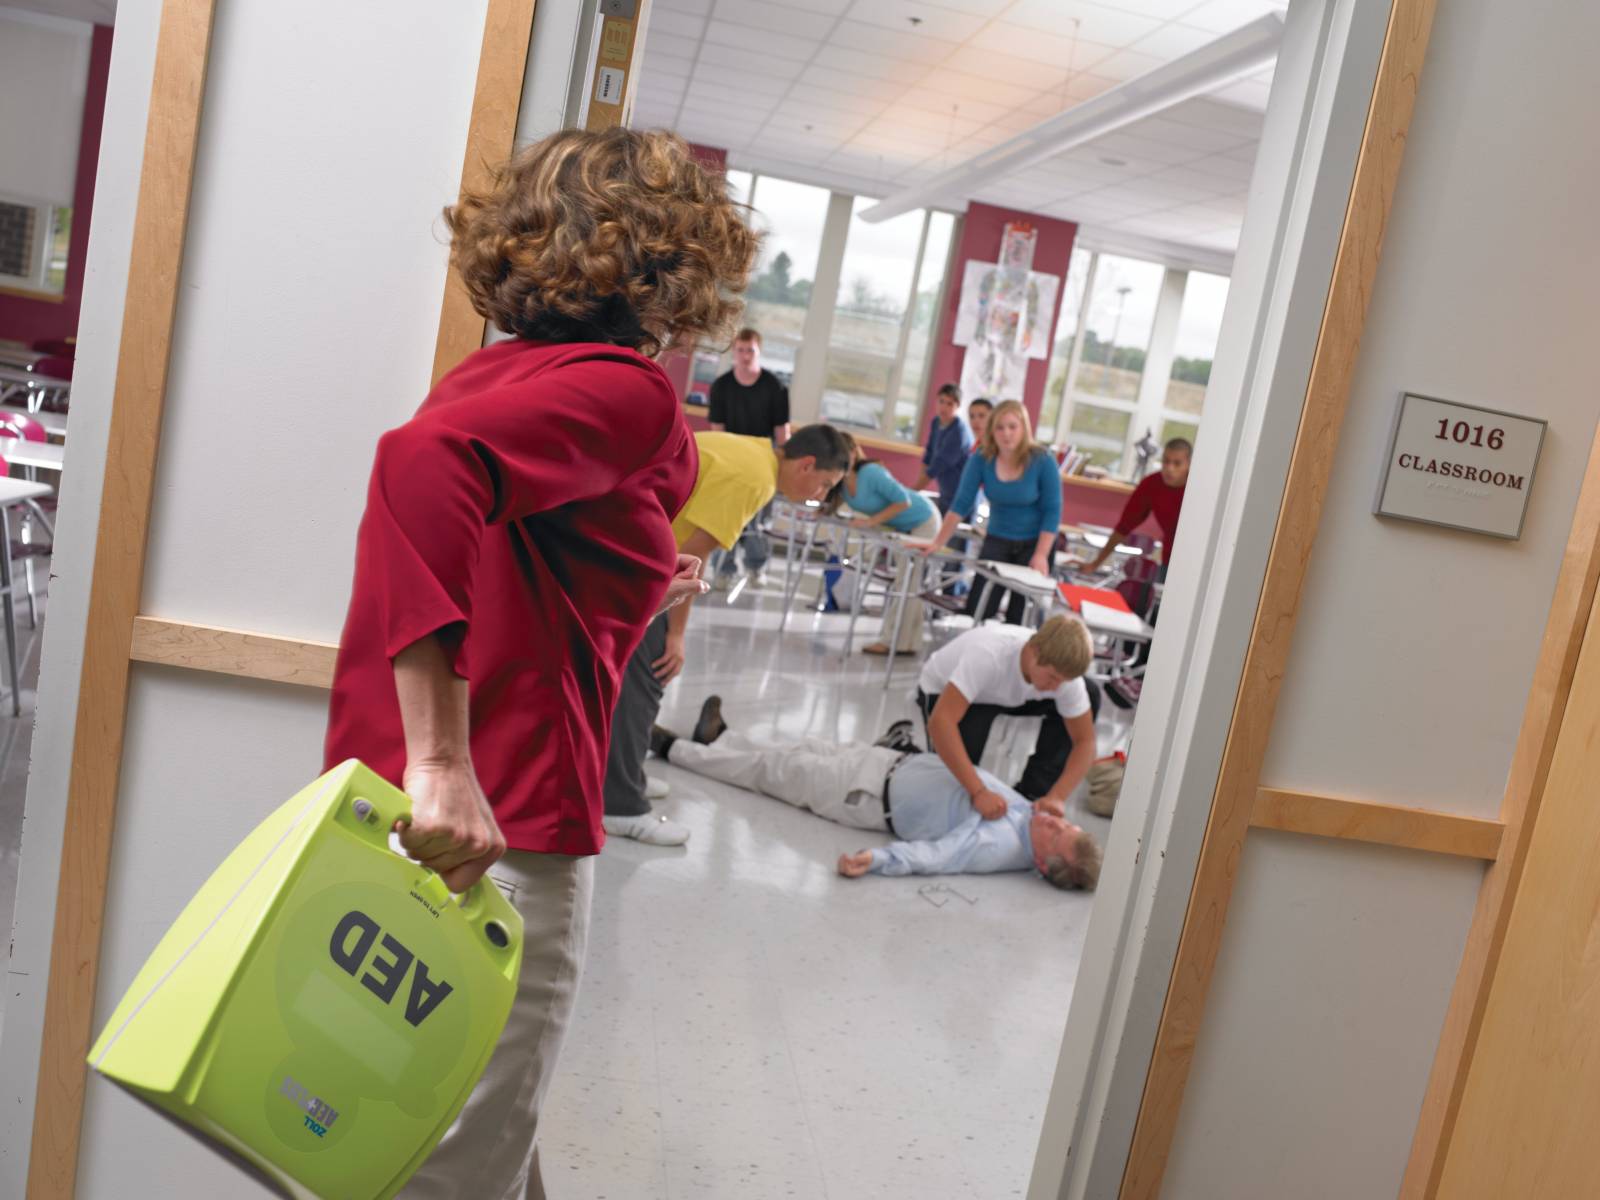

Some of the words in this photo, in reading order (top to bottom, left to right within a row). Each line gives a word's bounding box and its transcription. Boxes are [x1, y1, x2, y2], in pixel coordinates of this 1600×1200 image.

[1435, 417, 1506, 451] 1016
[1398, 453, 1525, 490] CLASSROOM
[329, 910, 454, 1028] AED
[304, 1114, 327, 1138] ZOLL
